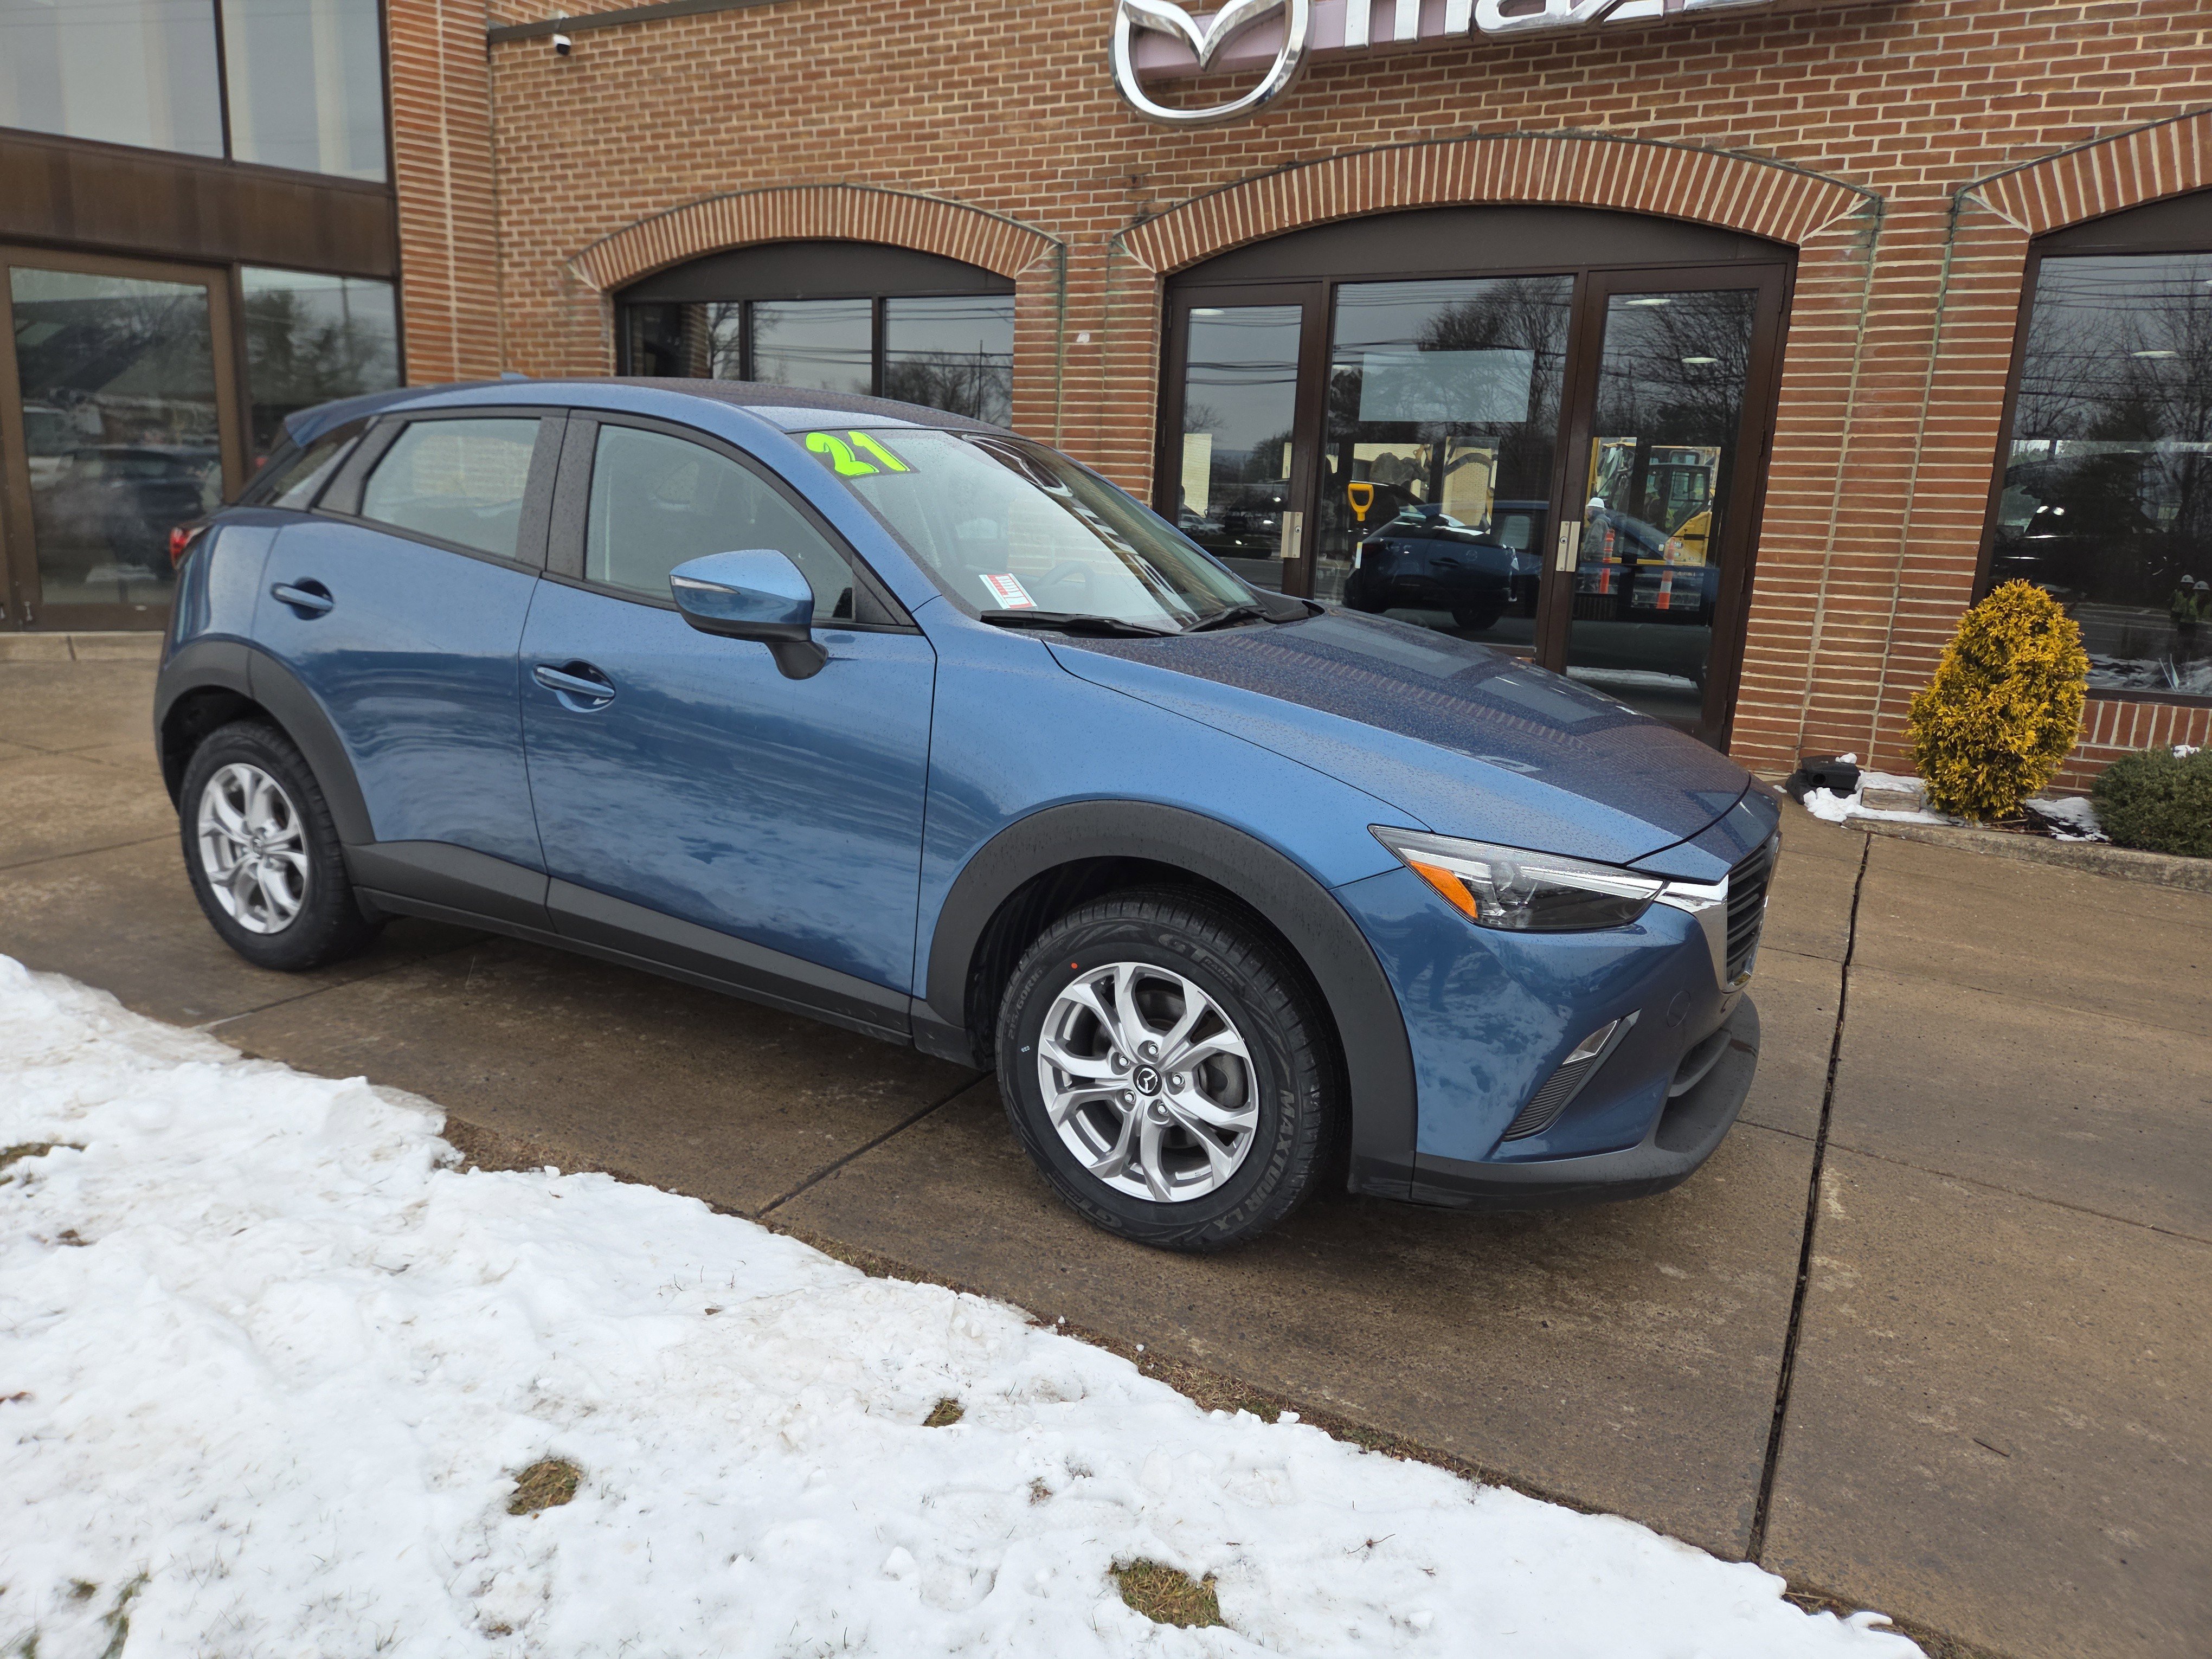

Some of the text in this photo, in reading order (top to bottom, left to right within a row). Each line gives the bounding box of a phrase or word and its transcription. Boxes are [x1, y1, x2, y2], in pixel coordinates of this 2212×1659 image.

[806, 431, 910, 476] 21
[1008, 967, 1043, 1040] 215/60R16
[1214, 1208, 1244, 1232] LX
